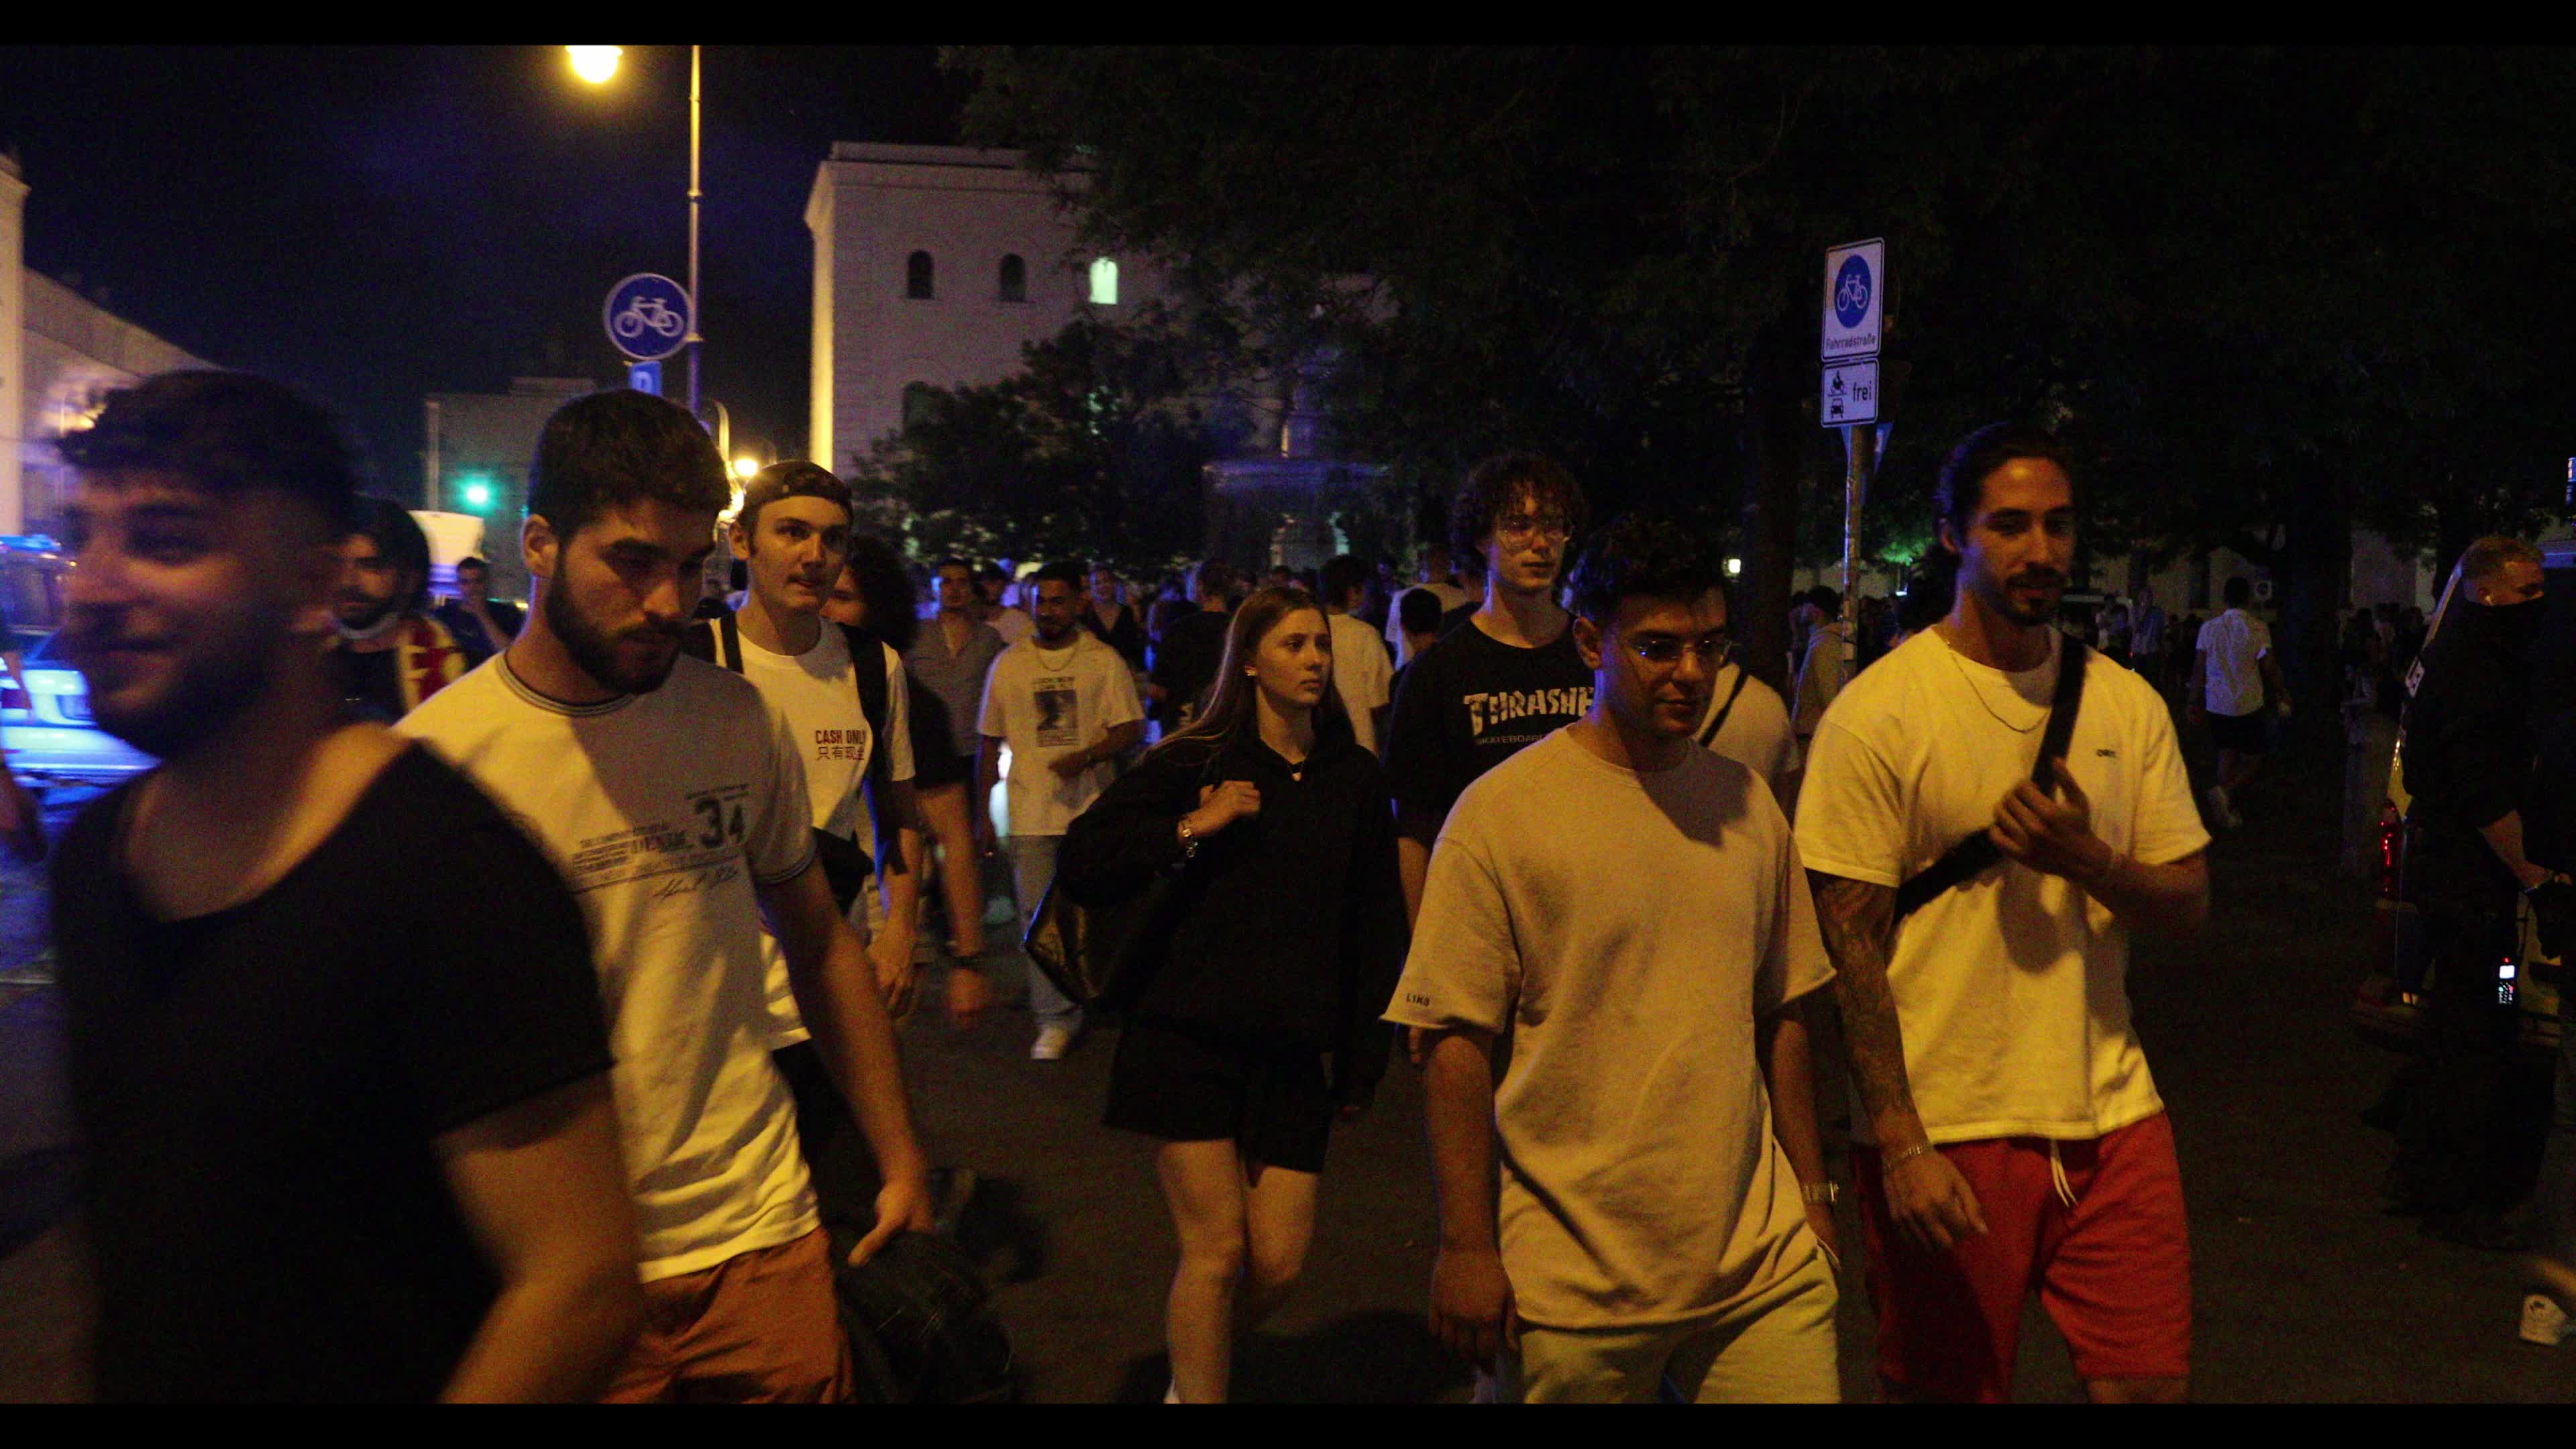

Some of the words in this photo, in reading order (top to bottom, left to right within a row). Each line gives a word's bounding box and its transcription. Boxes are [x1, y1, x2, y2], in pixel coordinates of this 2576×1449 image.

[1826, 333, 1876, 350] Fahrradstraße
[1853, 381, 1872, 402] frei
[1463, 686, 1595, 736] THRASHE
[815, 729, 843, 744] CASH
[846, 729, 867, 744] ONLY
